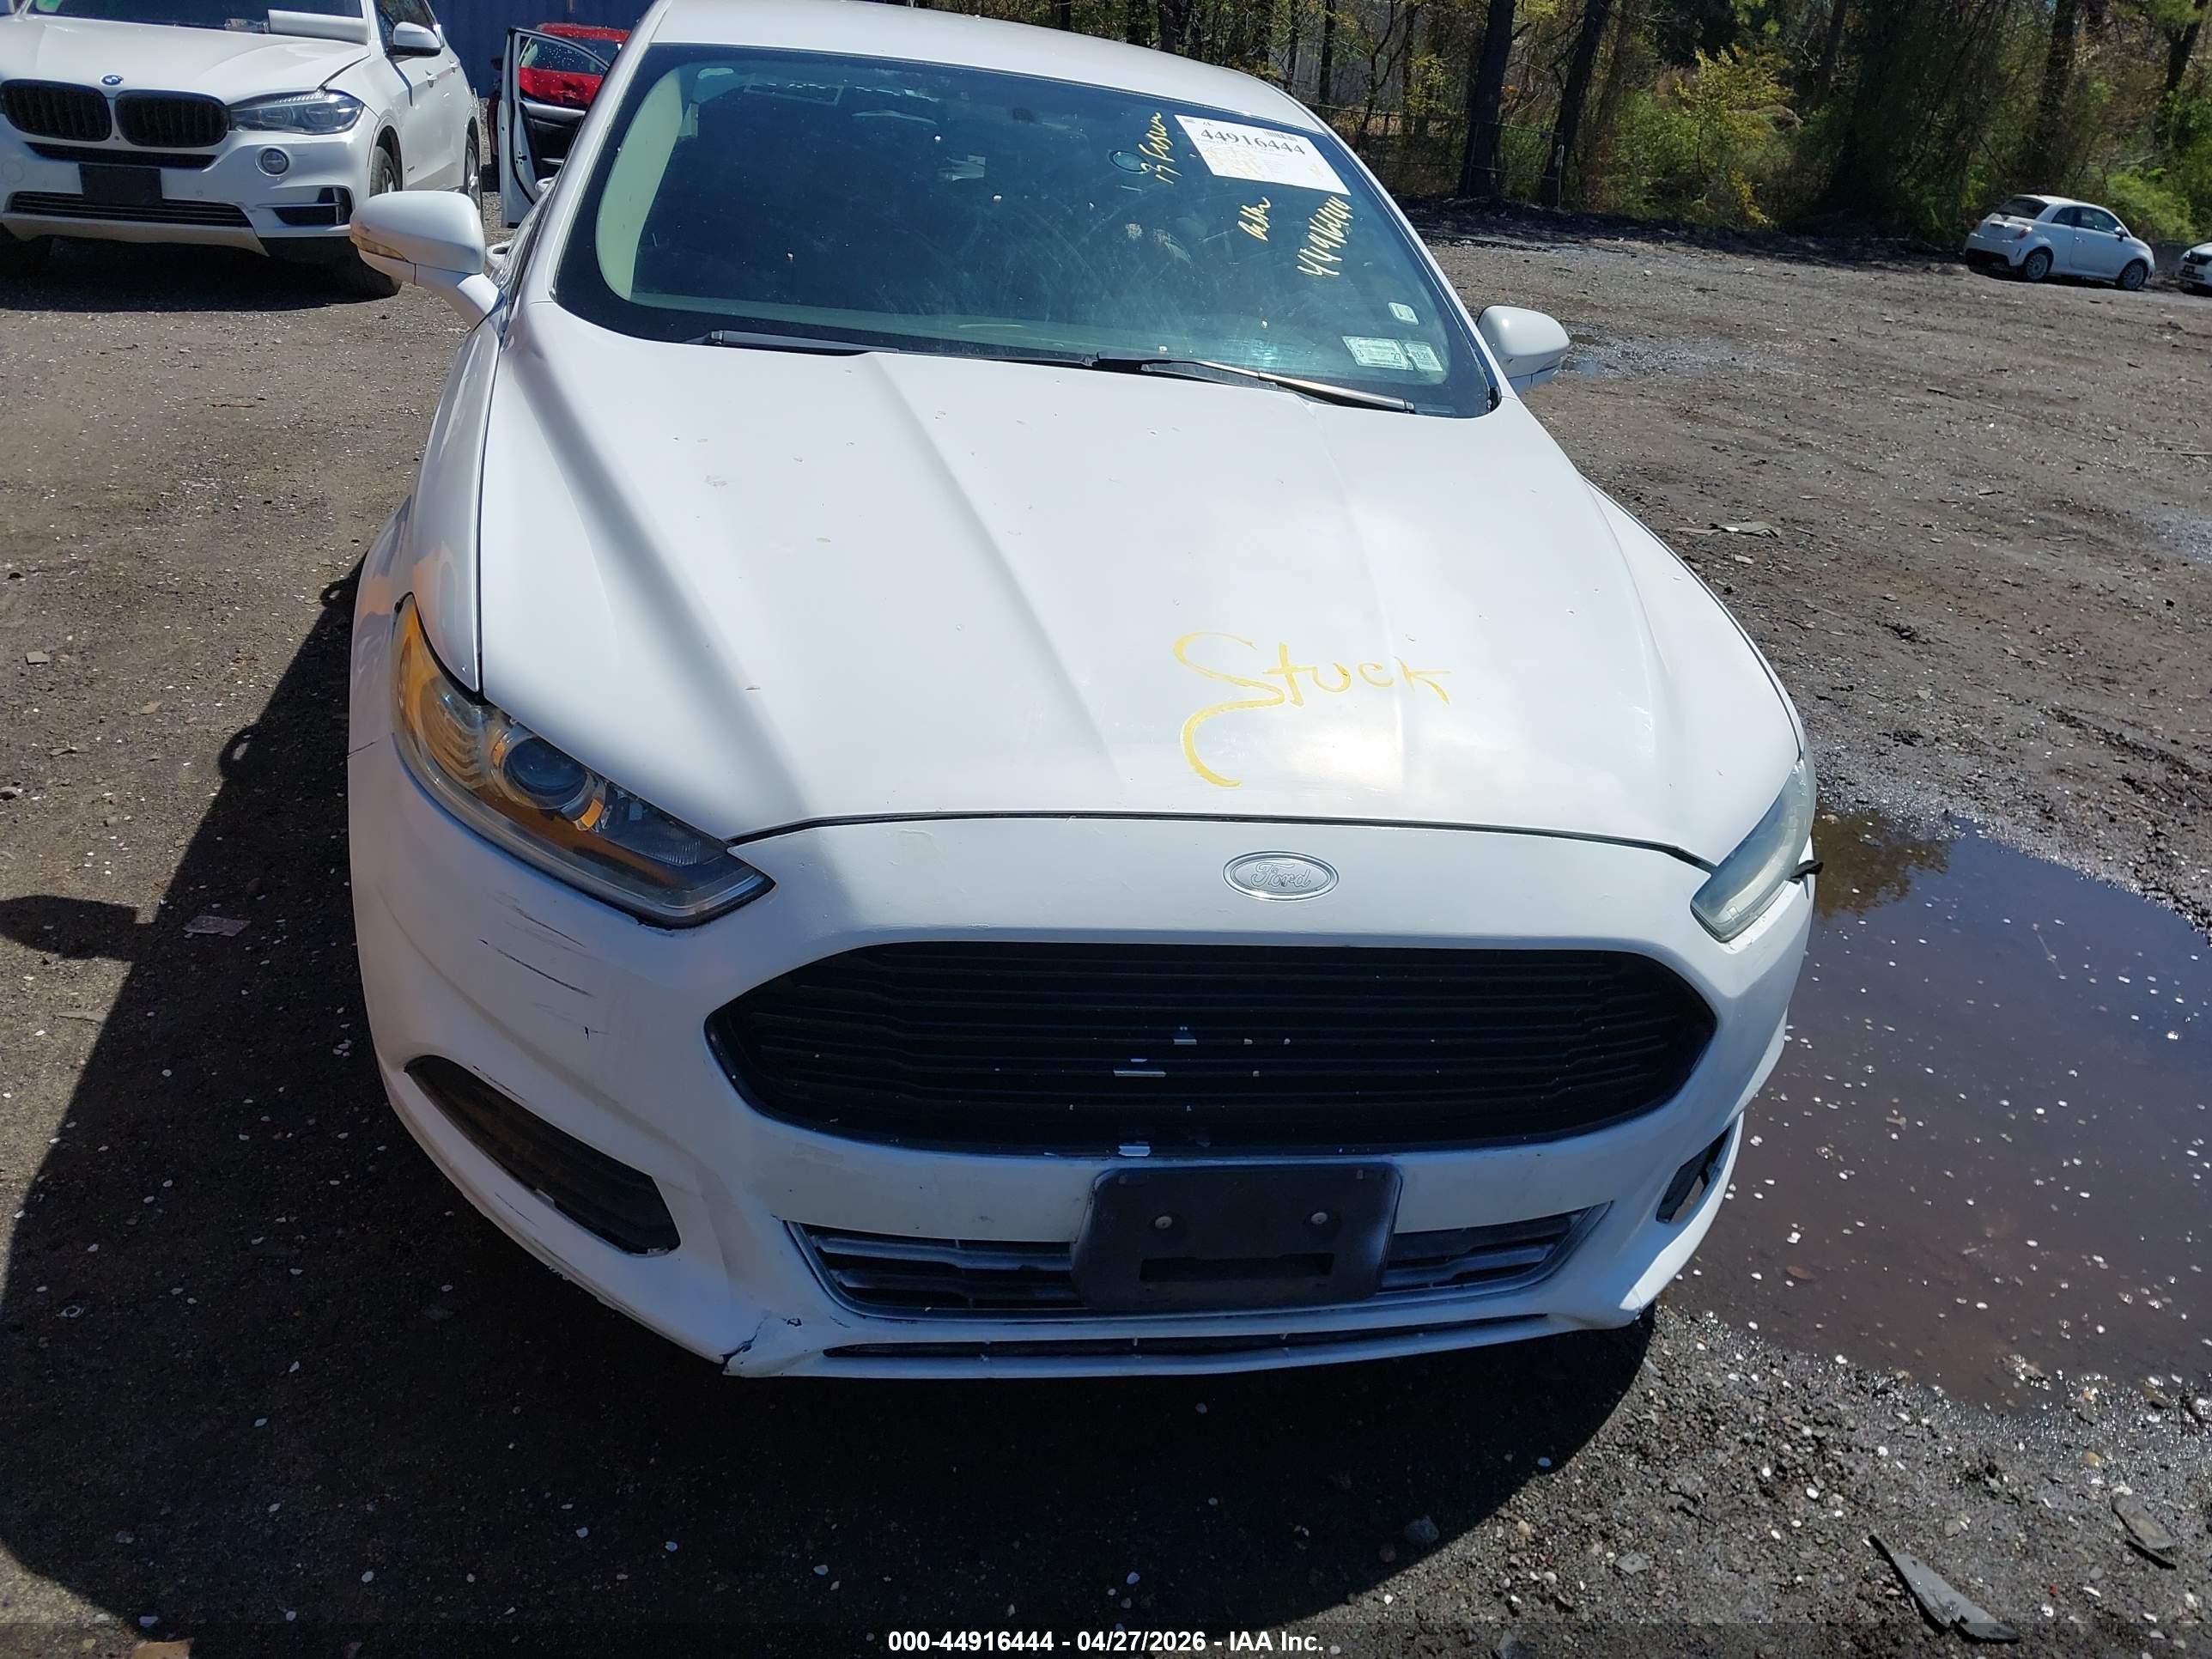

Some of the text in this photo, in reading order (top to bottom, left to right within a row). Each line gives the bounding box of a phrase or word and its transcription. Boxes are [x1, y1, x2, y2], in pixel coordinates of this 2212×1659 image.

[1200, 129, 1306, 155] 44916444
[1173, 631, 1451, 787] Stuck
[1249, 861, 1311, 888] Ford
